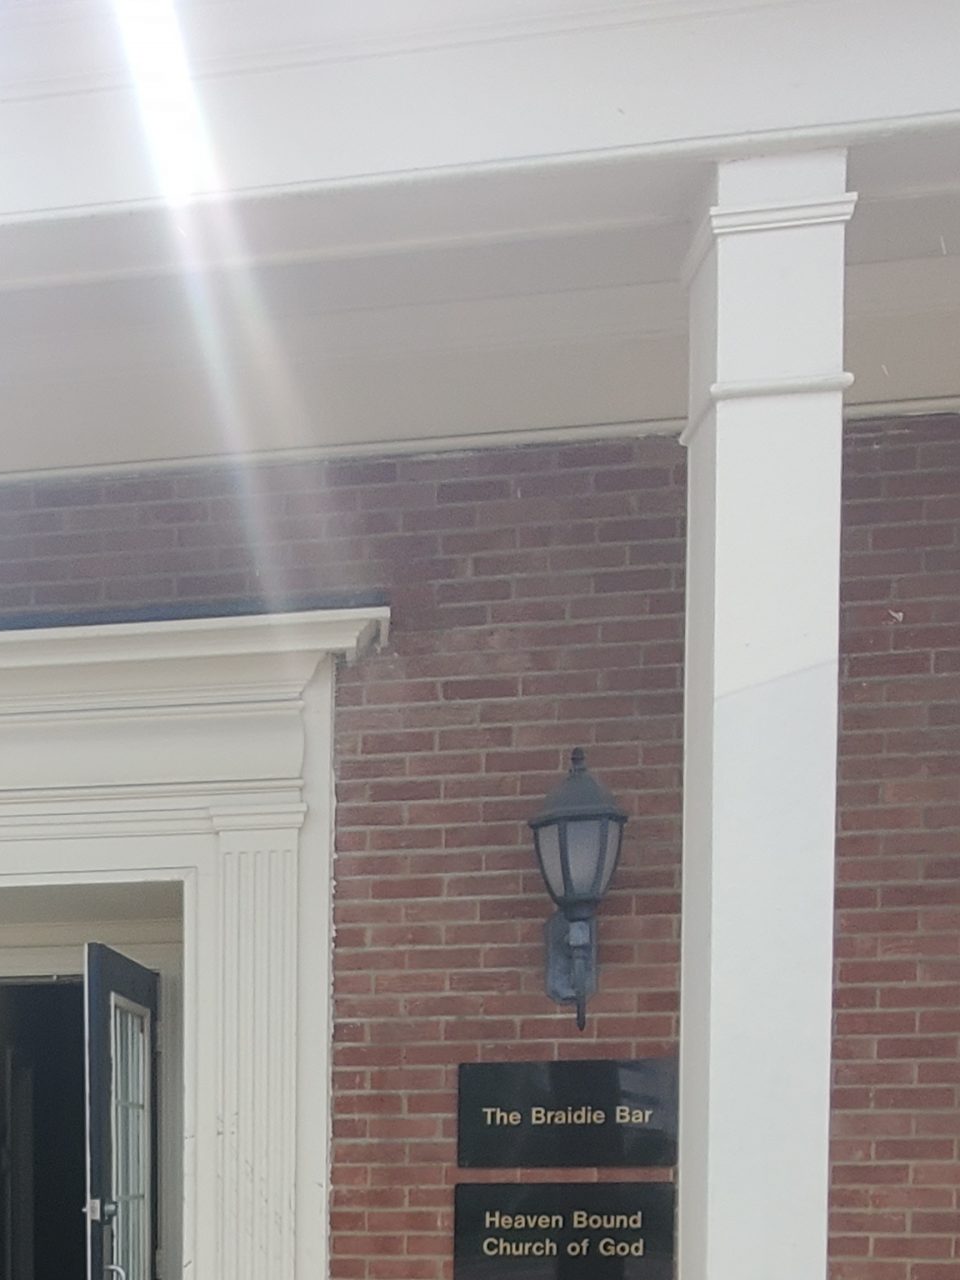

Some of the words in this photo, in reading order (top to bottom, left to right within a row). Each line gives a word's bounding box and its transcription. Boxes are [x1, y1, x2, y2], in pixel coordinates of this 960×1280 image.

[482, 1108, 522, 1125] The
[531, 1107, 606, 1125] Braidie
[615, 1106, 653, 1124] Bar
[485, 1211, 564, 1229] Heaven
[573, 1211, 642, 1229] Bound
[483, 1238, 558, 1256] Church
[567, 1238, 590, 1256] of
[599, 1238, 644, 1256] God
